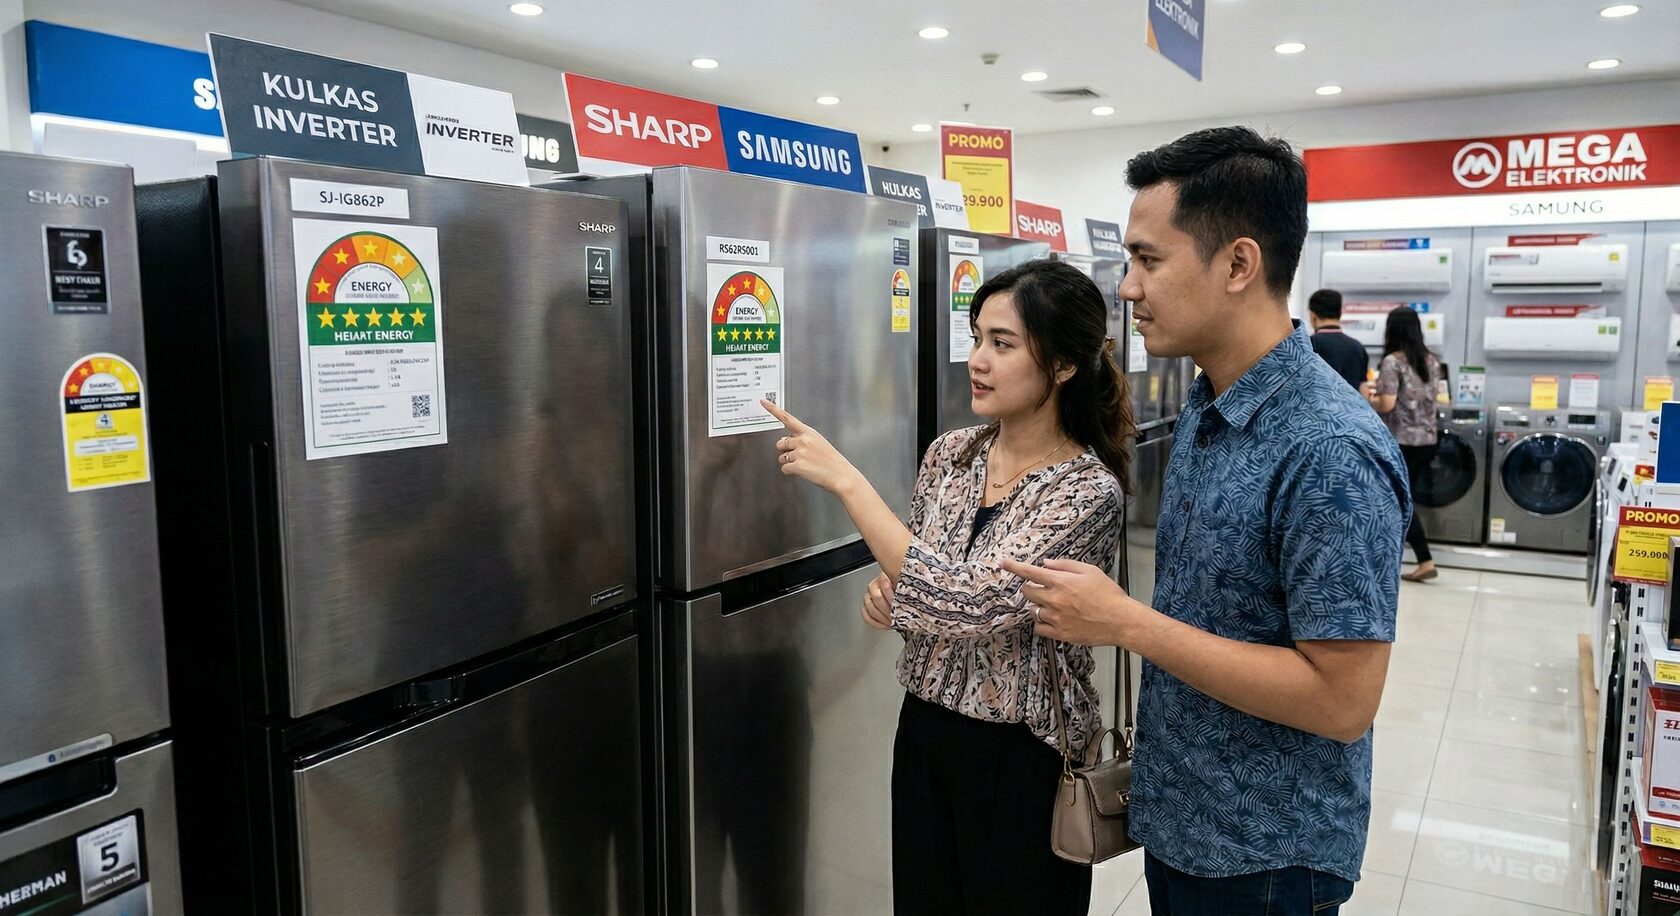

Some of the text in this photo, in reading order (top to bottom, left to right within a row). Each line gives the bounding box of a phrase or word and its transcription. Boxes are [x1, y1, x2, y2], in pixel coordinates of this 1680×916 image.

[262, 72, 379, 113] KULKAS
[253, 104, 398, 147] INVERTER
[426, 122, 514, 148] INVERTER
[584, 104, 712, 149] SHARP
[949, 133, 1004, 150] PROMO
[1507, 132, 1647, 169] MEGA
[737, 130, 852, 175] SAMSUNG
[1506, 163, 1647, 187] ELEKTRONIK
[28, 189, 110, 208] SHARP
[320, 191, 384, 207] SJ-IG862P
[1508, 199, 1604, 217] SAMUNG
[579, 221, 616, 234] SHARP
[1017, 214, 1061, 237] SHARP
[594, 256, 604, 273] 4
[351, 281, 392, 292] ENERGY
[735, 307, 759, 316] ENERGY
[375, 330, 414, 340] ENERGY
[1626, 510, 1680, 525] PROMO
[101, 842, 119, 871] 5
